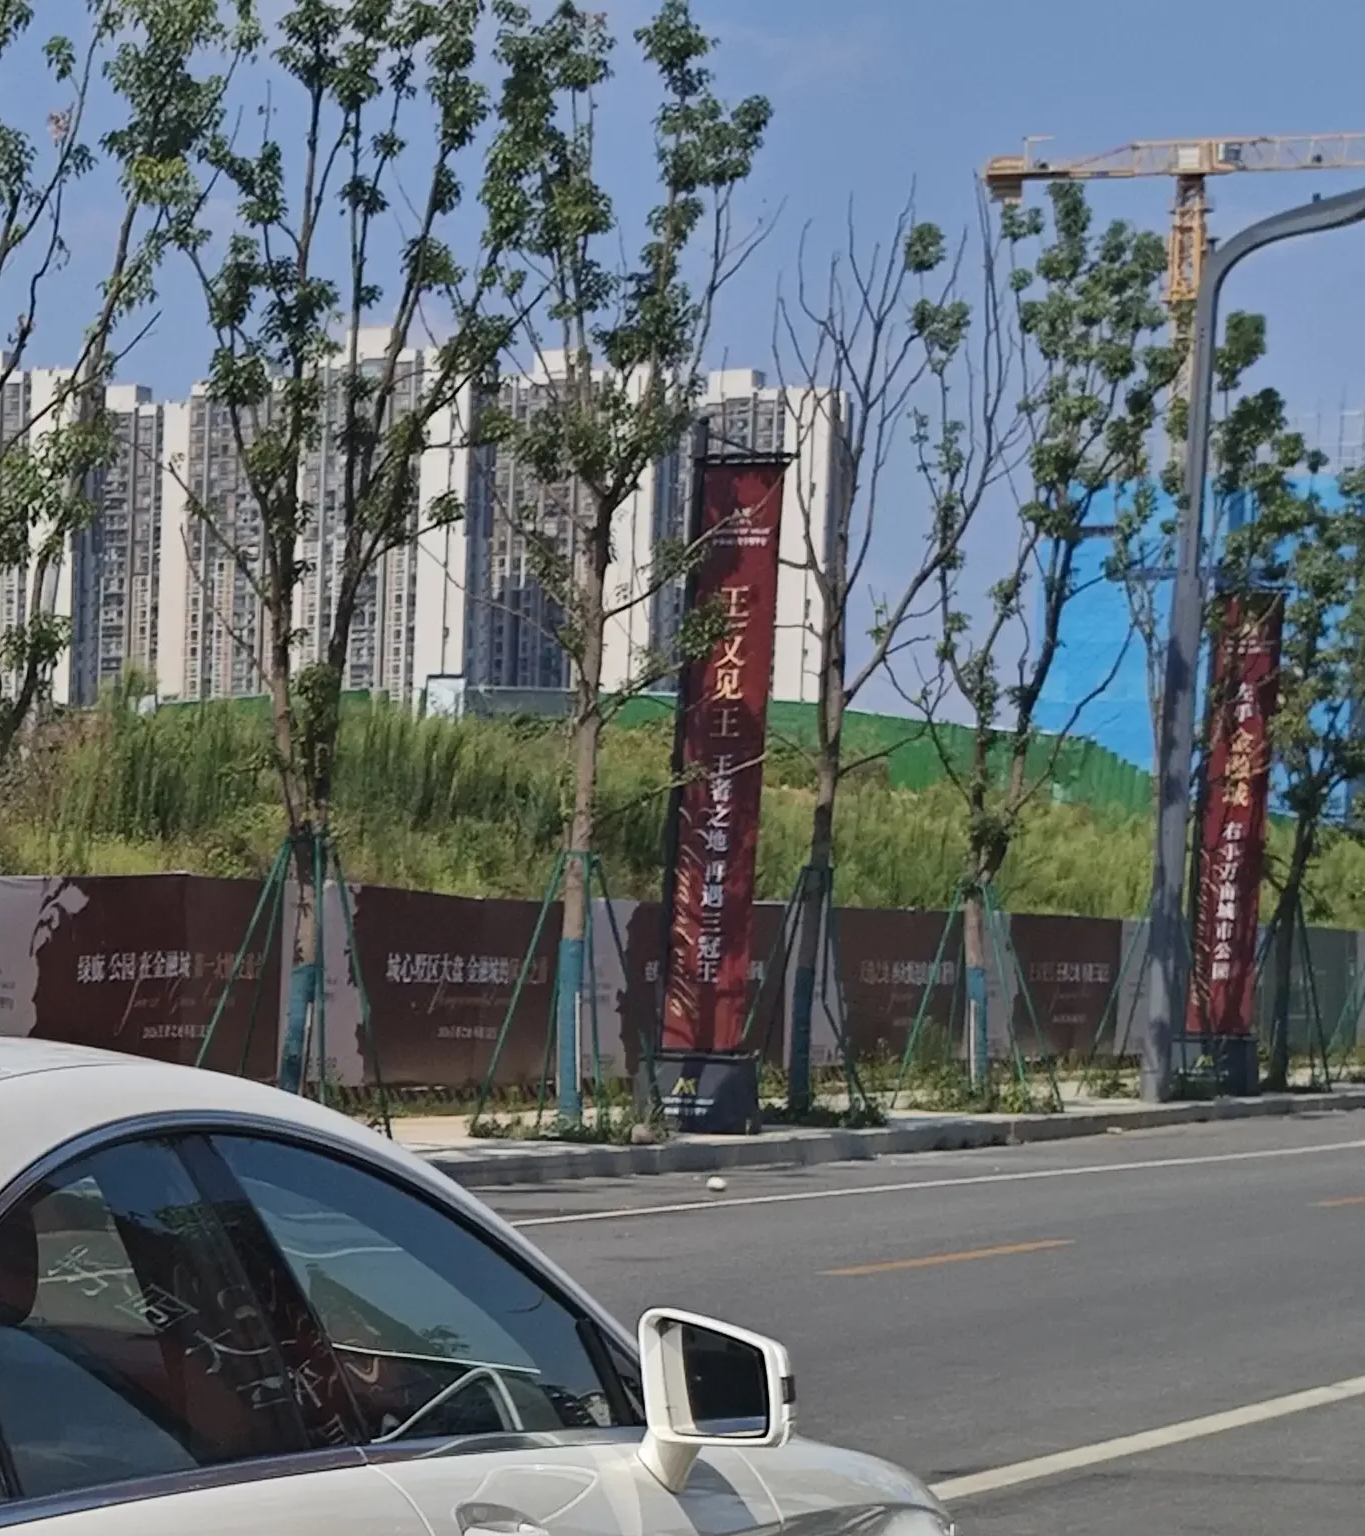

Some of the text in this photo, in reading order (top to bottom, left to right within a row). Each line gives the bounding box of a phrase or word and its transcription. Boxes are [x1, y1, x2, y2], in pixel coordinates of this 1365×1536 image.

[697, 860, 727, 984] 再遇三冠王
